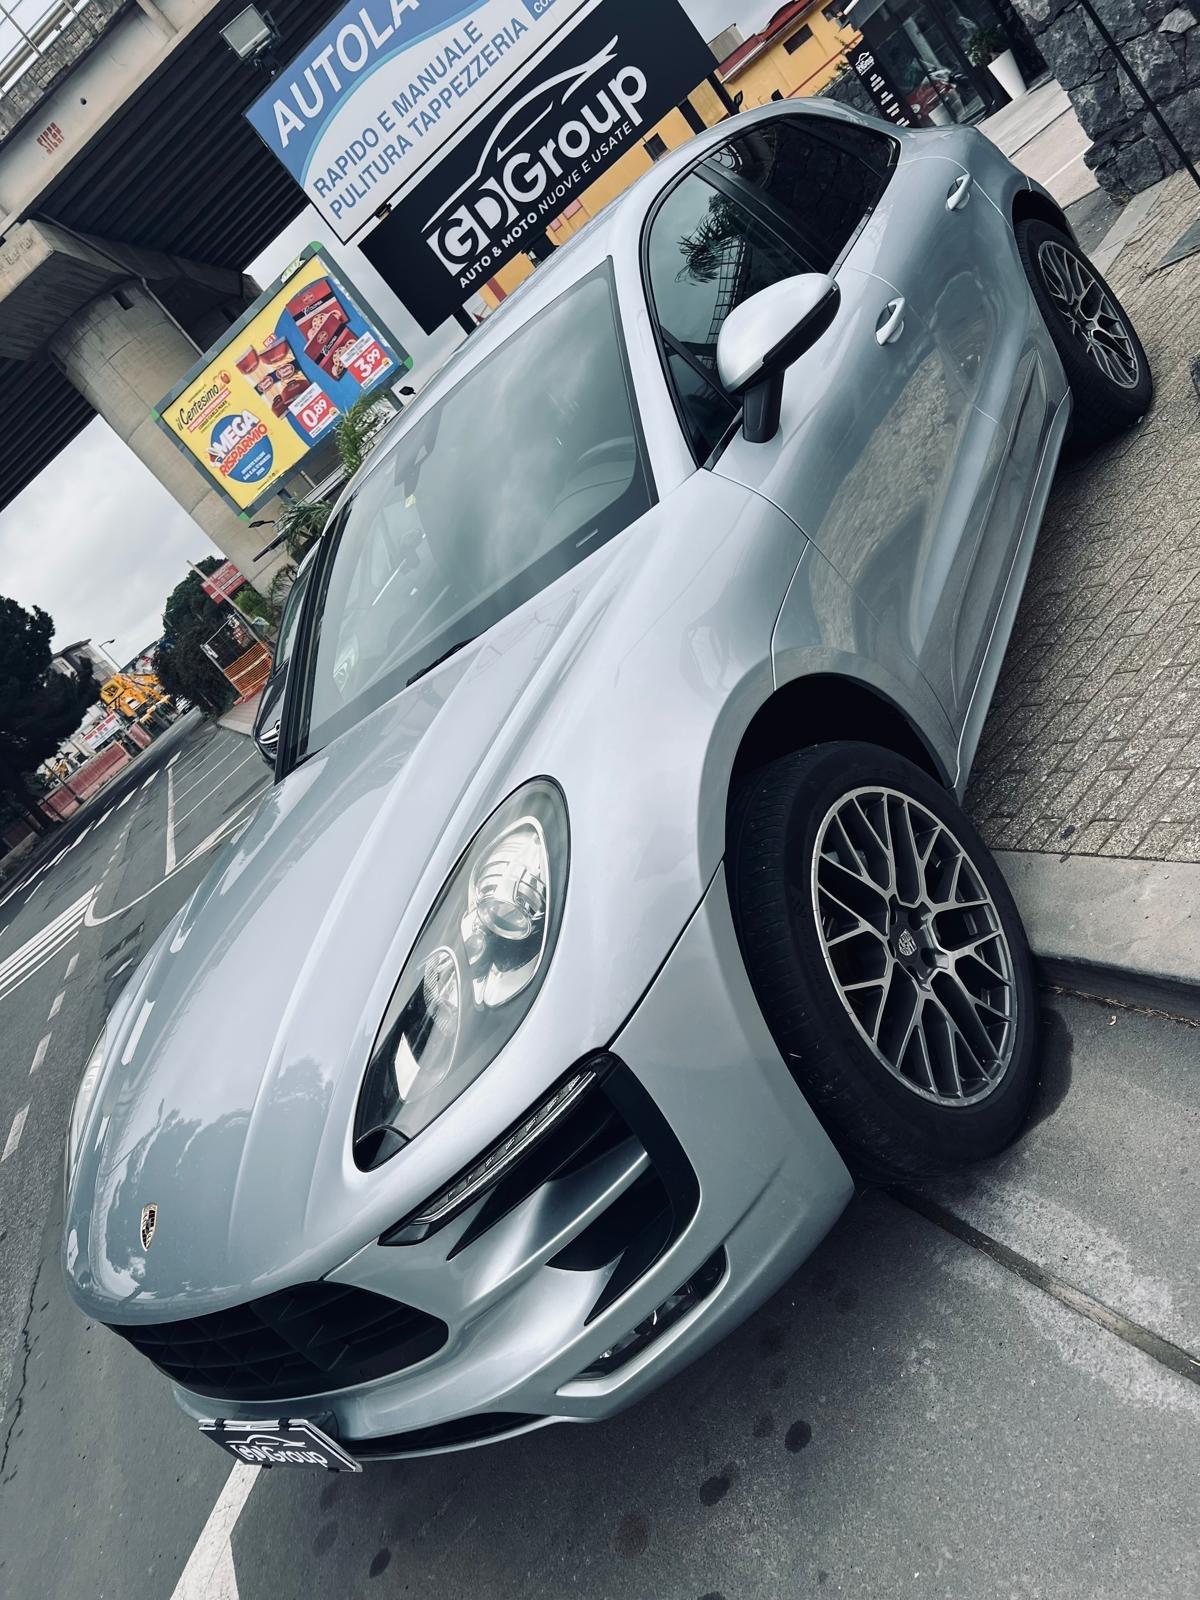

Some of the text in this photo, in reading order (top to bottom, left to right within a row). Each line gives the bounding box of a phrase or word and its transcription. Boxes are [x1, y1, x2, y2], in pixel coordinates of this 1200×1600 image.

[313, 20, 483, 199] RAPIDO E MANUALE
[329, 17, 528, 220] PULITURA TAPPEZZERIA
[458, 121, 632, 288] AUTO & MOTO NUOVE E USATE
[176, 416, 184, 431] il
[179, 384, 219, 425] Centesimo
[212, 410, 261, 460] MEGA
[219, 423, 268, 477] RISPARMIO
